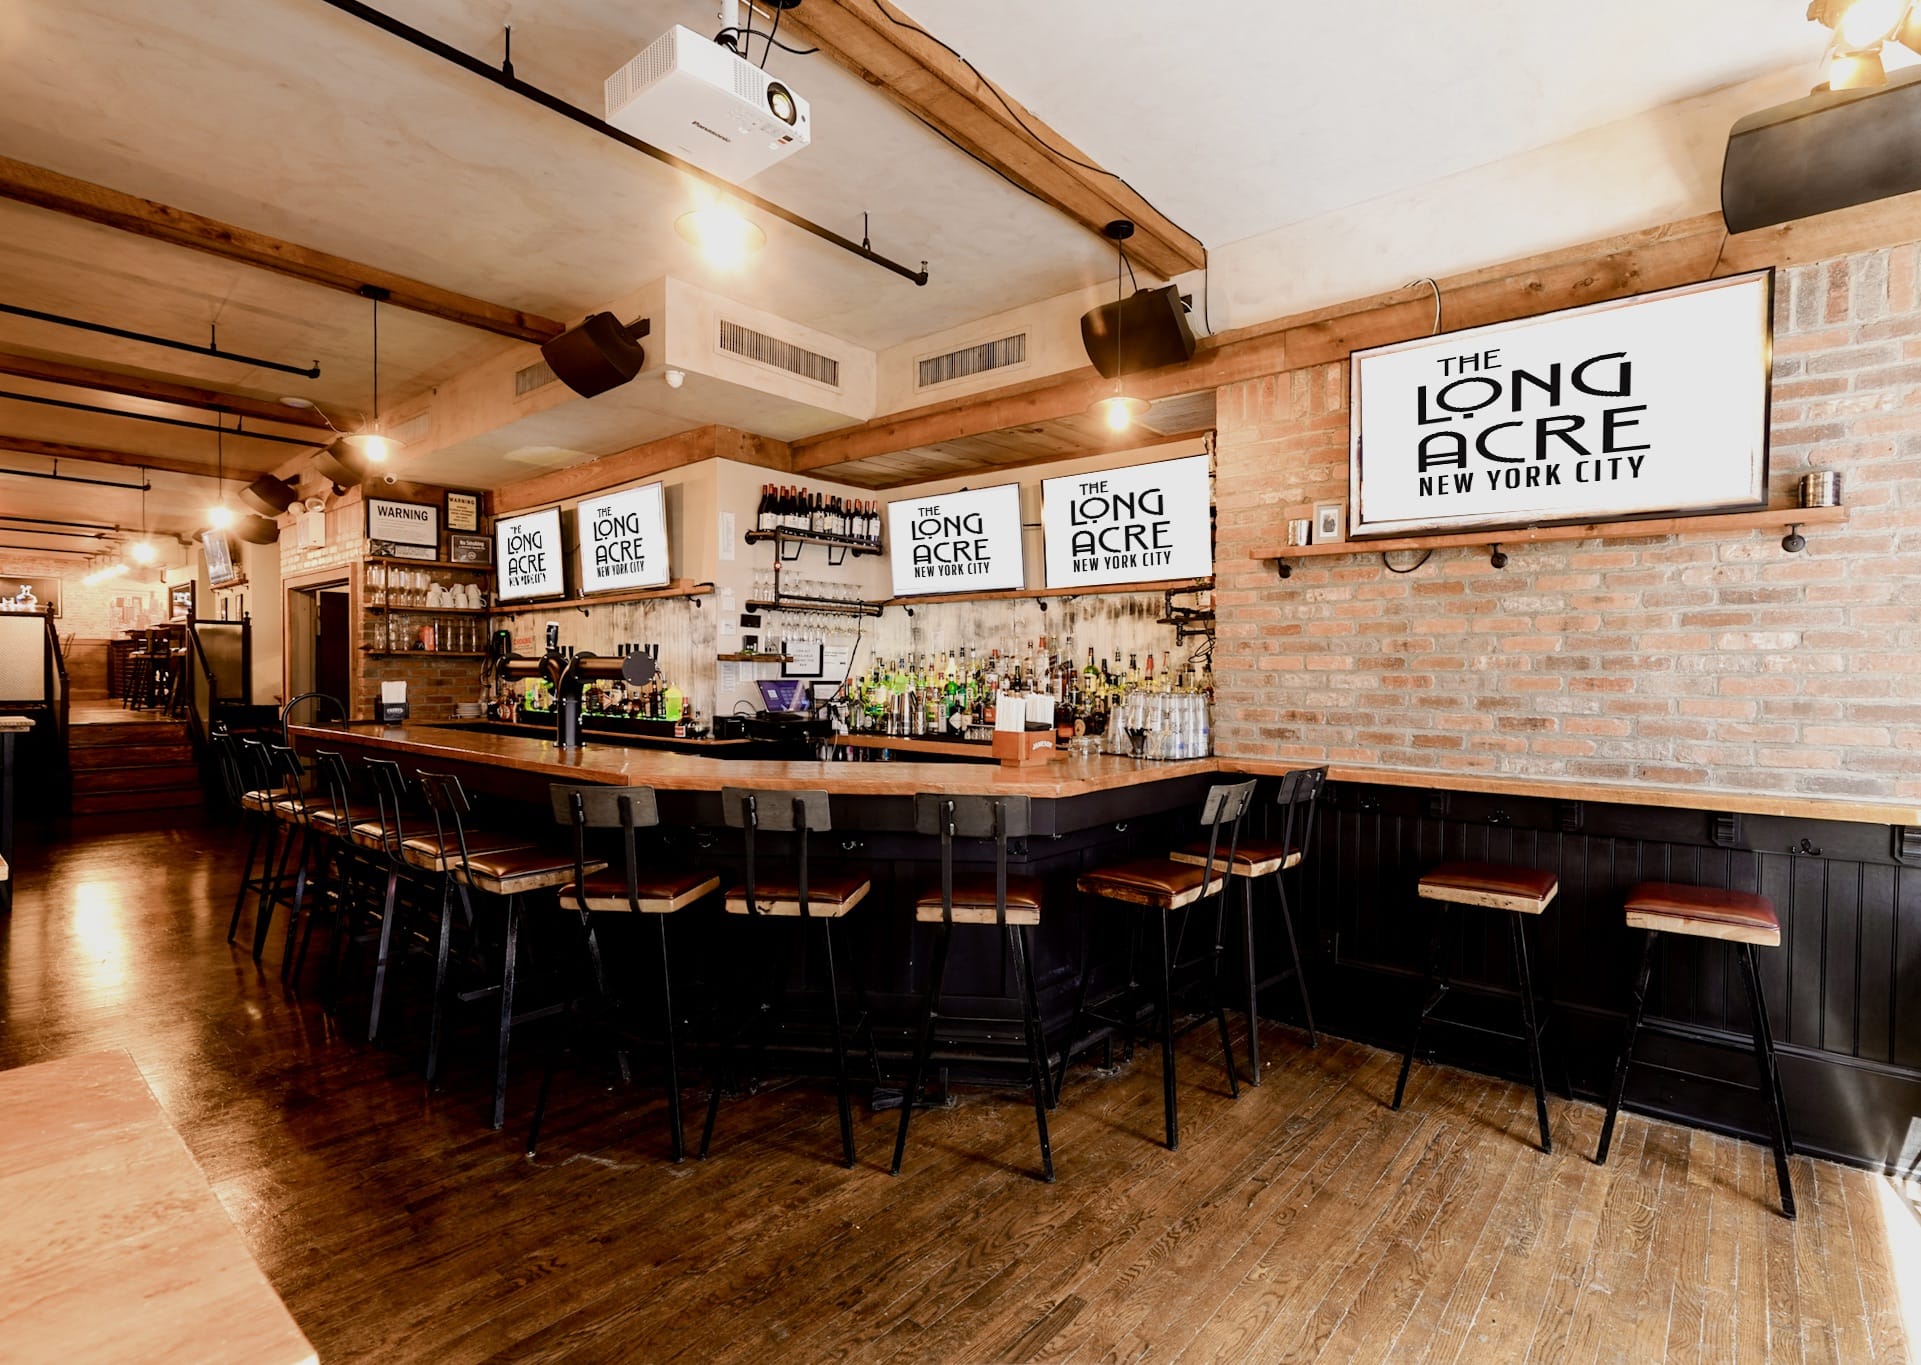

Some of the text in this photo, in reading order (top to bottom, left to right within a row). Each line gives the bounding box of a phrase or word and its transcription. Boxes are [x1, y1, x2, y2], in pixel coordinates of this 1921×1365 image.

[1437, 348, 1502, 377] THE
[1418, 351, 1632, 426] LONG
[1418, 404, 1651, 473] ACRE
[1079, 480, 1109, 495] THE
[1419, 455, 1645, 497] NEW YORK CITY
[377, 505, 428, 521] WARNING
[449, 497, 475, 505] WARNING
[597, 506, 612, 518] THE
[918, 505, 940, 517] THE
[1070, 488, 1164, 526] LONG
[593, 512, 639, 541] LONG
[911, 513, 983, 541] LONG
[1072, 521, 1173, 557] ACRE
[507, 530, 542, 554] LONG
[595, 537, 645, 566] ACRE
[913, 538, 991, 565] ACRE
[508, 552, 546, 576] ACRE
[597, 560, 645, 577] NEW YORK CITY
[914, 561, 990, 578] NEW YORK CITY
[1073, 551, 1171, 573] NEW YORK CITY
